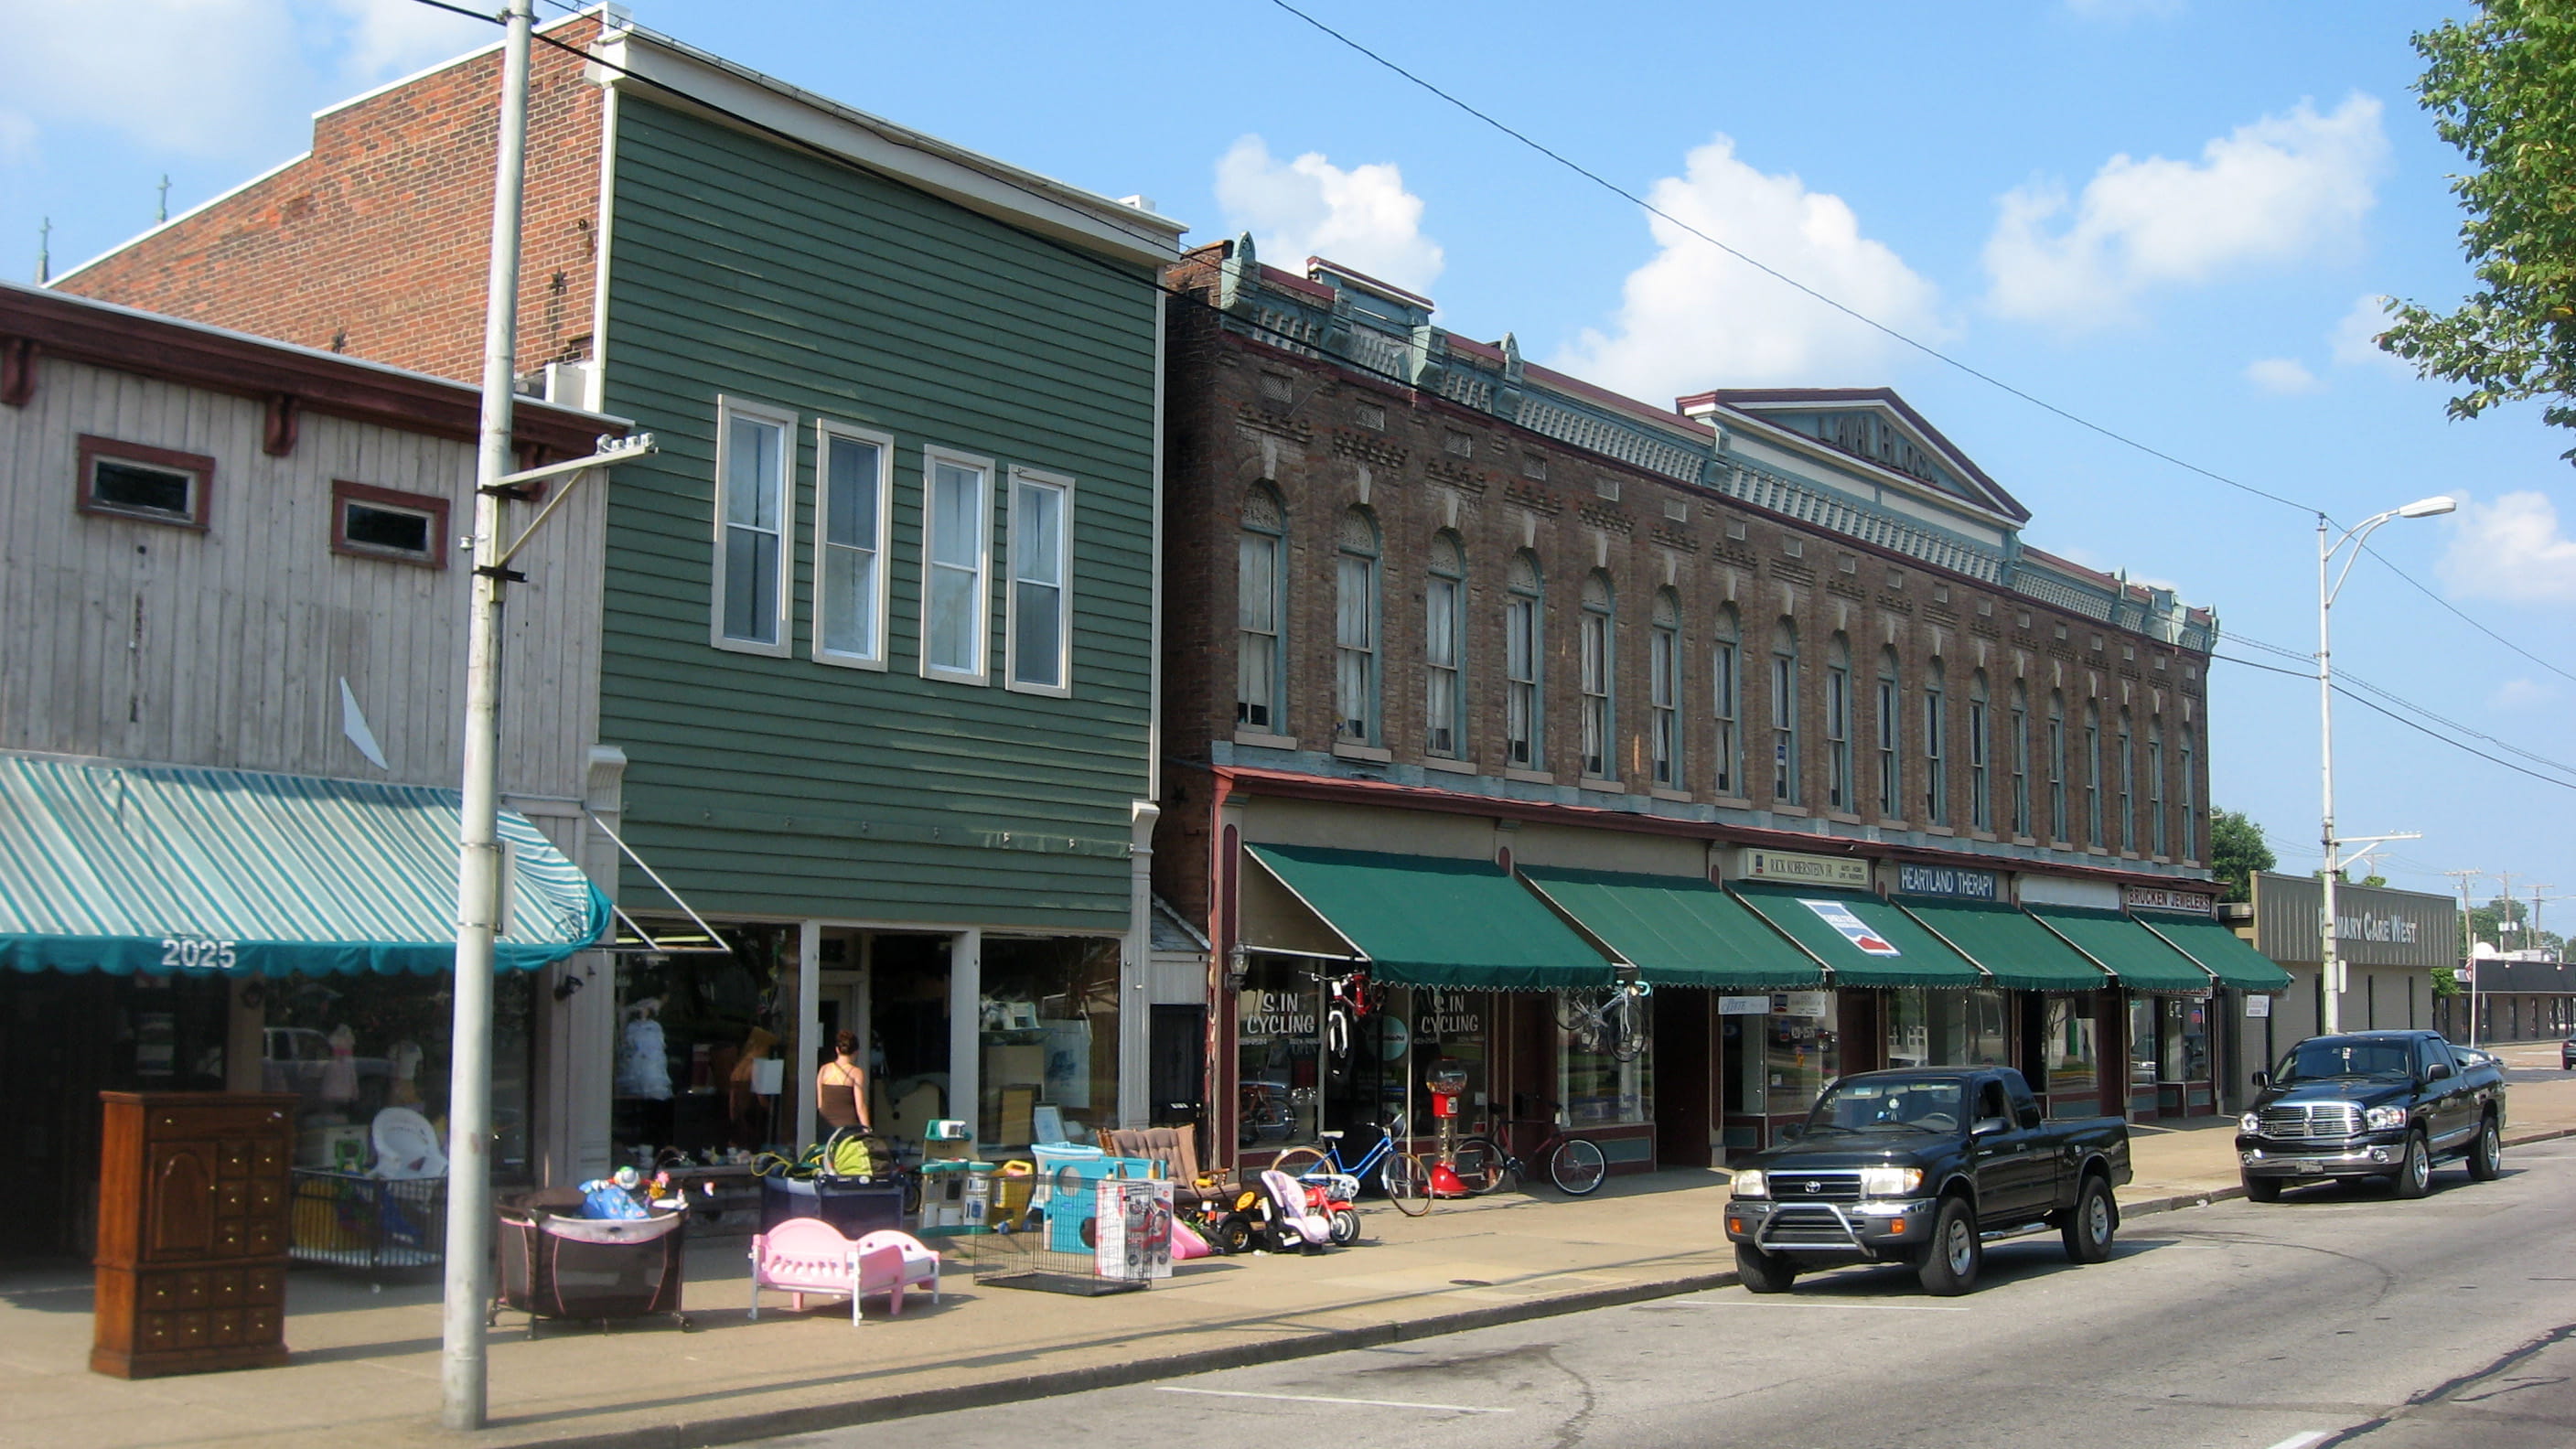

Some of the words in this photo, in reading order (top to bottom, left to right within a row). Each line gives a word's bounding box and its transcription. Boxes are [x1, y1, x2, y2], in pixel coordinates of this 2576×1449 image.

[1901, 866, 1954, 893] HEARTLAND
[1957, 871, 1994, 897] THERAPY
[2129, 886, 2168, 906] BRUCKEN
[2170, 891, 2210, 911] JEWELERS
[2363, 911, 2390, 942] CARE
[2390, 914, 2418, 944] WEST
[161, 939, 237, 968] 2025
[1247, 1014, 1315, 1034] CYCLING
[1421, 1014, 1479, 1034] CYCLING
